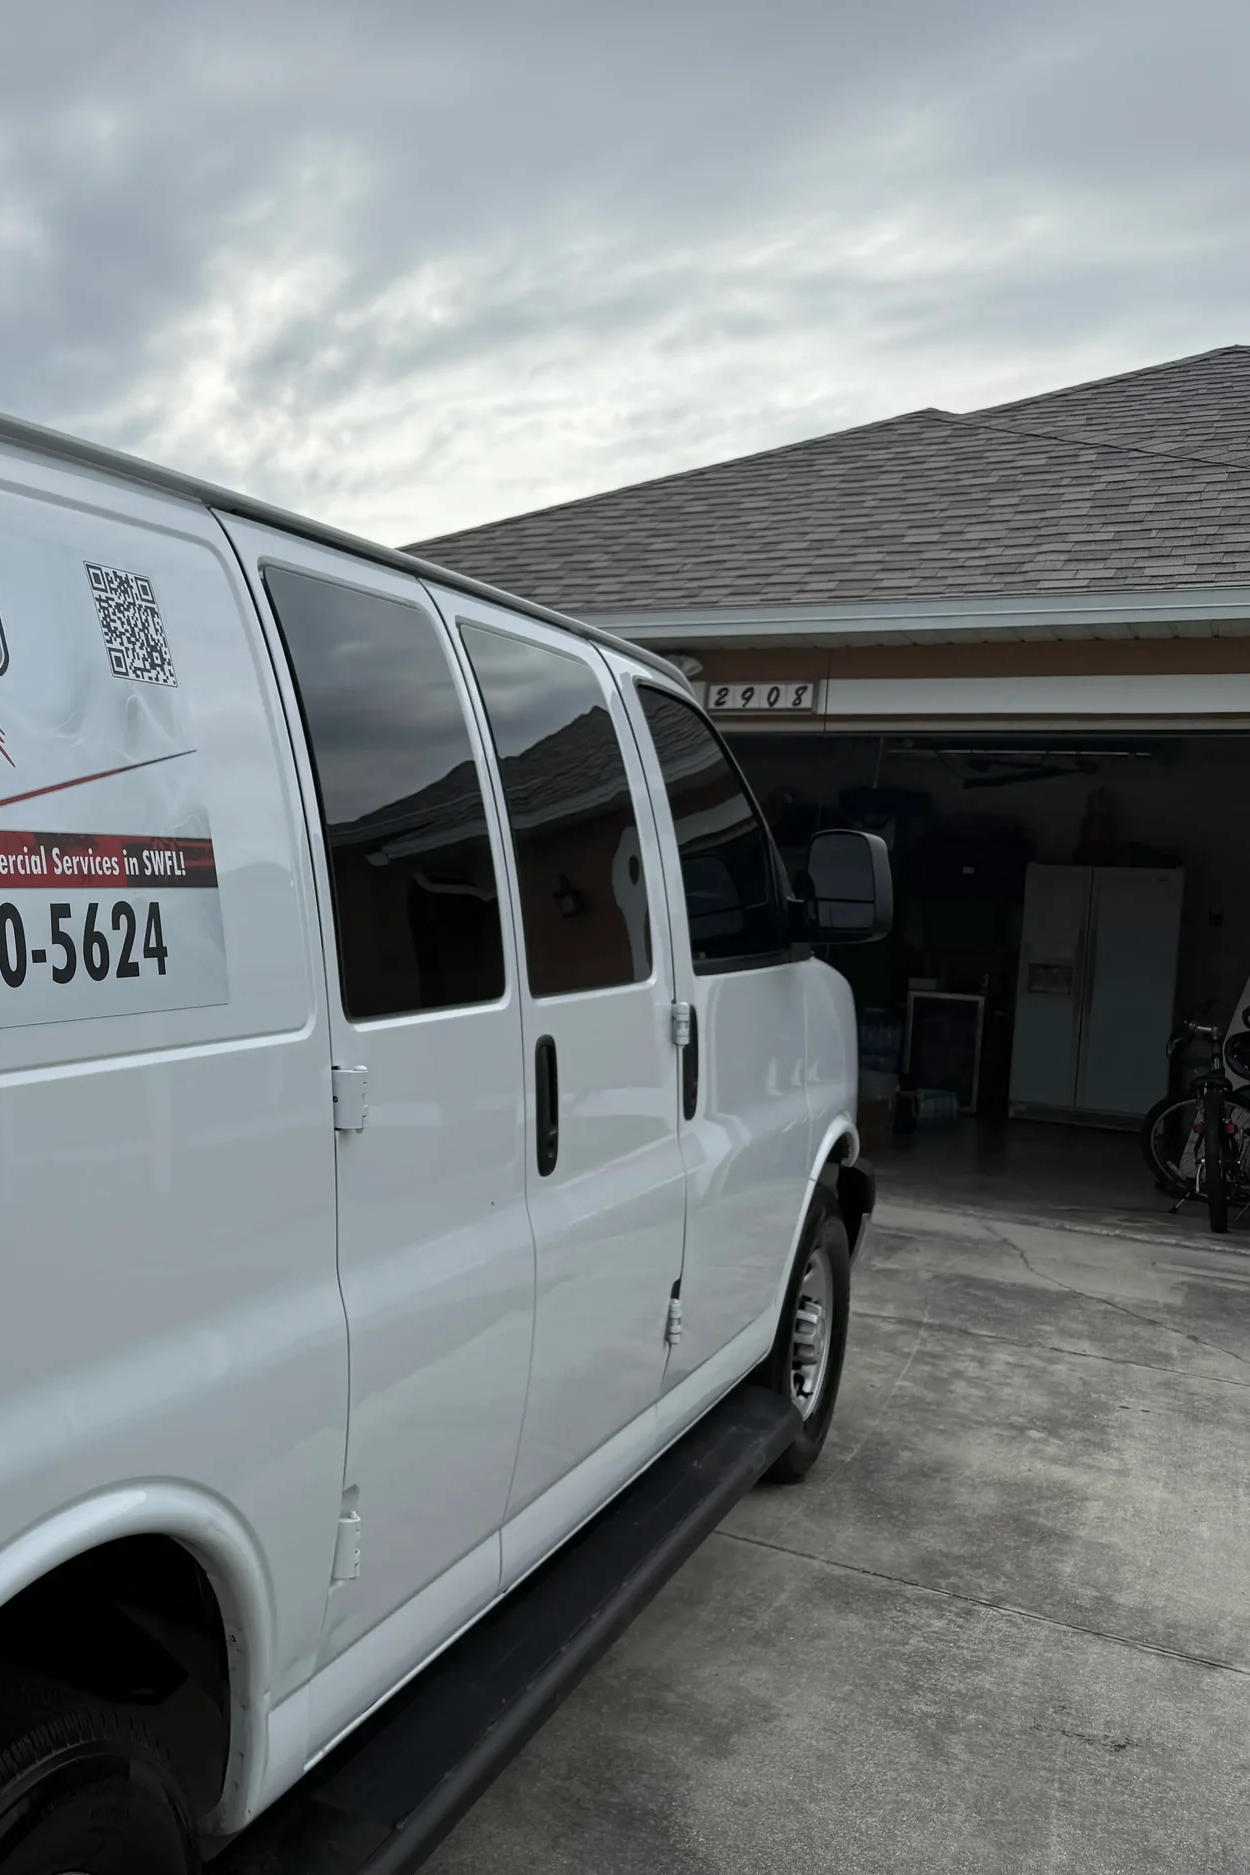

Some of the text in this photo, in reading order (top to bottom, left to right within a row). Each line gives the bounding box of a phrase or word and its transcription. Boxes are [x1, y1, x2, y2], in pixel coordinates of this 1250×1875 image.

[714, 685, 808, 708] 2908
[52, 847, 120, 876] Services
[123, 849, 140, 876] in
[144, 850, 187, 876] SWFL!
